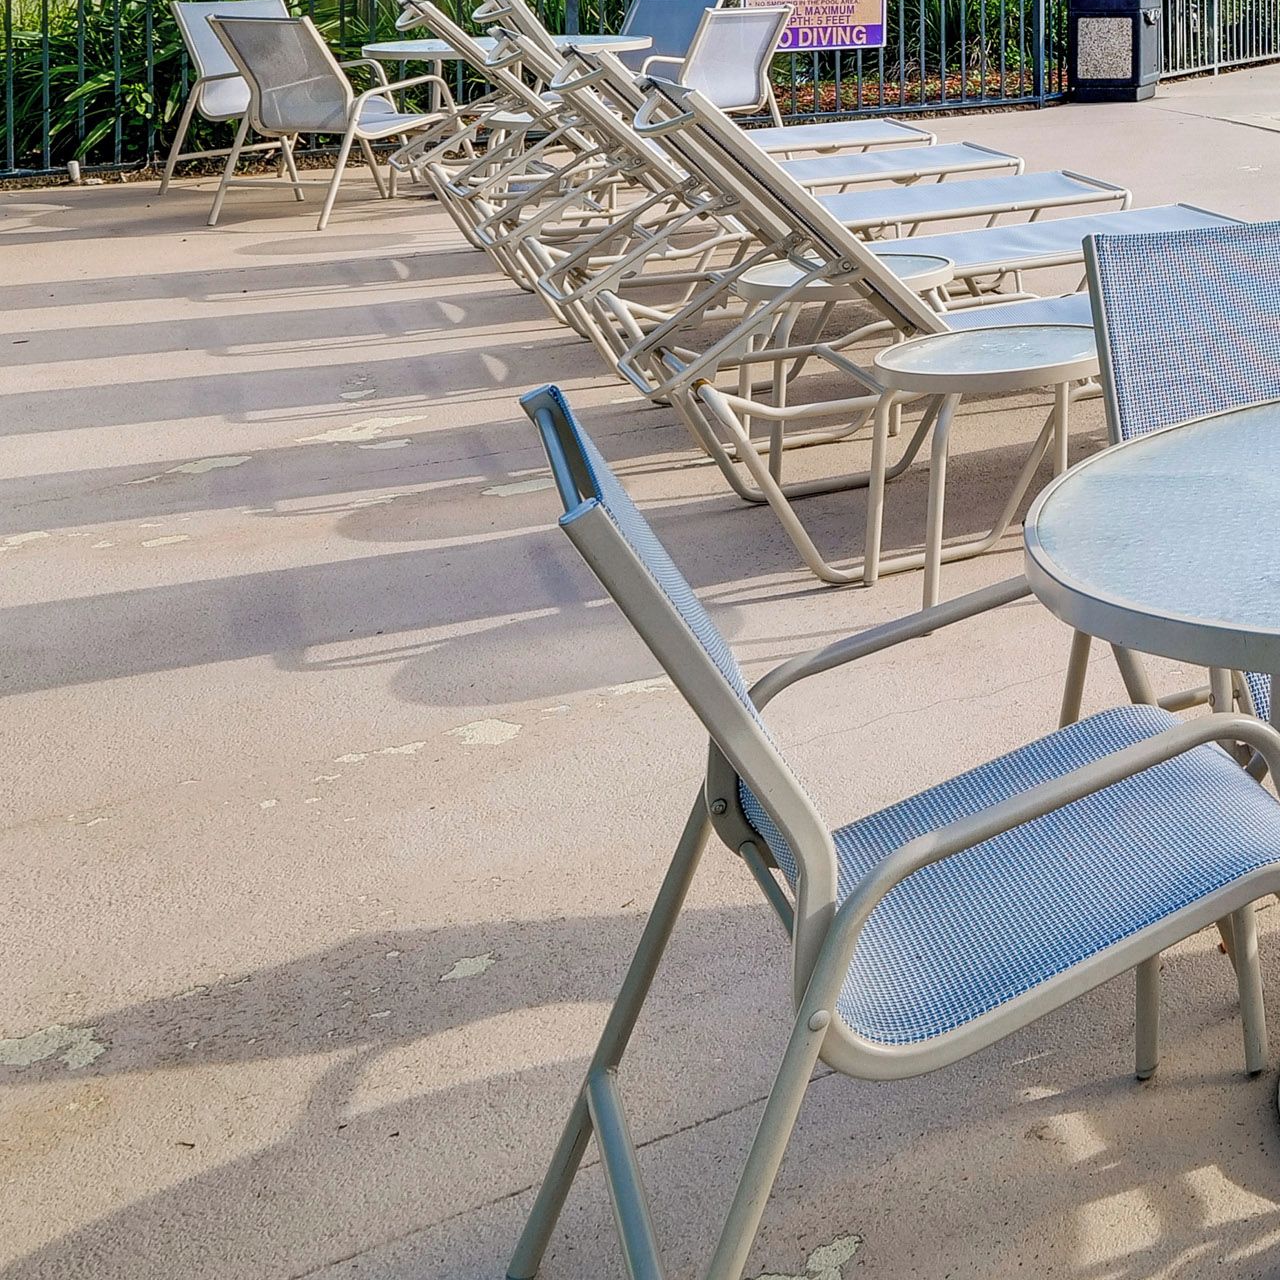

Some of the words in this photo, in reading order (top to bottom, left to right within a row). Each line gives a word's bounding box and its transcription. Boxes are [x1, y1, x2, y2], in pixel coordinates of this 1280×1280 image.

[805, 5, 854, 16] MAXIMUM
[816, 16, 822, 25] 5
[826, 15, 851, 25] FEET
[778, 28, 792, 48] O
[798, 26, 866, 47] DIVING
